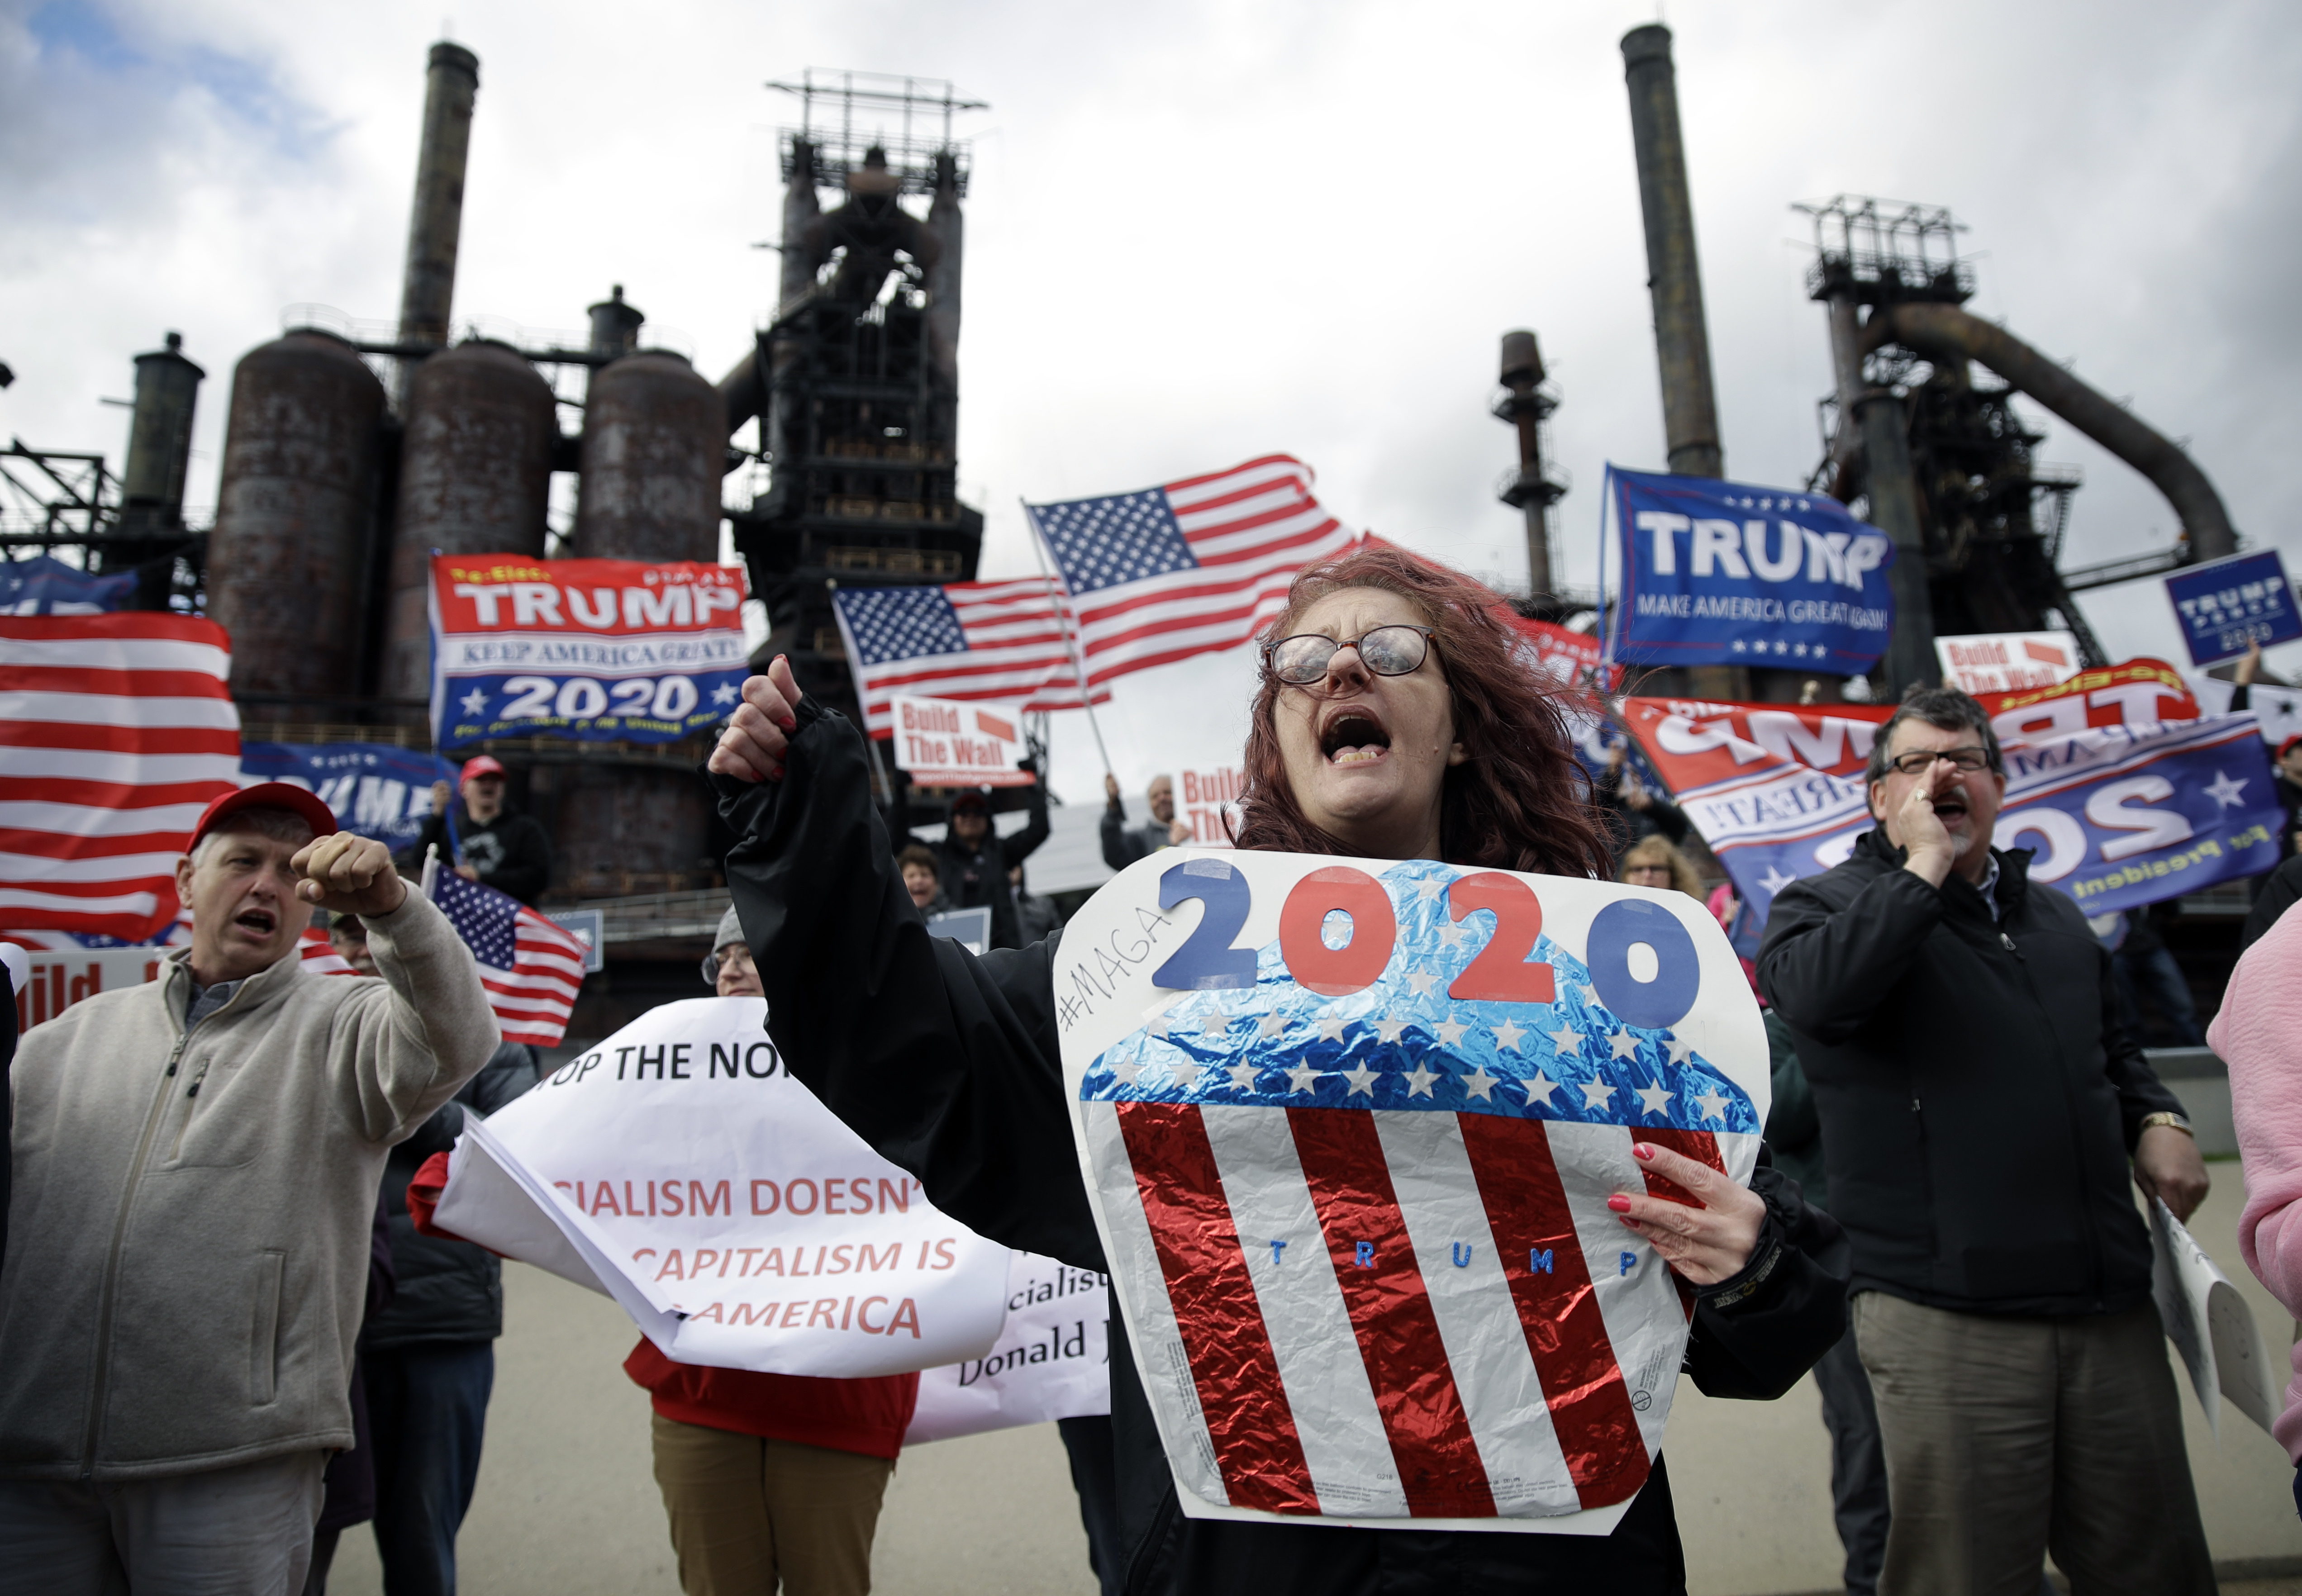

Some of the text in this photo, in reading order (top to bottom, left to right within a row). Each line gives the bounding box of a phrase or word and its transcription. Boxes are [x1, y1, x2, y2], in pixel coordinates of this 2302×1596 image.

[1636, 510, 1888, 591] TRUMP
[453, 582, 740, 629] TRUMP
[1637, 593, 1692, 618] MAKE
[1693, 595, 1786, 622] AMERICA
[2178, 575, 2284, 619] TRUMP
[537, 642, 656, 665] AMERICA
[1949, 641, 2008, 666] Build
[499, 674, 699, 721] 2020
[1959, 671, 2001, 695] The
[903, 703, 960, 733] Build
[906, 735, 1004, 766] The Wall
[1151, 858, 1701, 1030] 2020
[1059, 907, 1172, 1032] #MAGA
[615, 1044, 691, 1081] THE
[709, 1042, 790, 1079] NO
[750, 1178, 922, 1216] DOESN'
[917, 1238, 956, 1270] IS
[1270, 1239, 1639, 1277] TRUMP
[689, 1296, 922, 1340] AMERICA
[959, 1320, 1086, 1387] Donald
